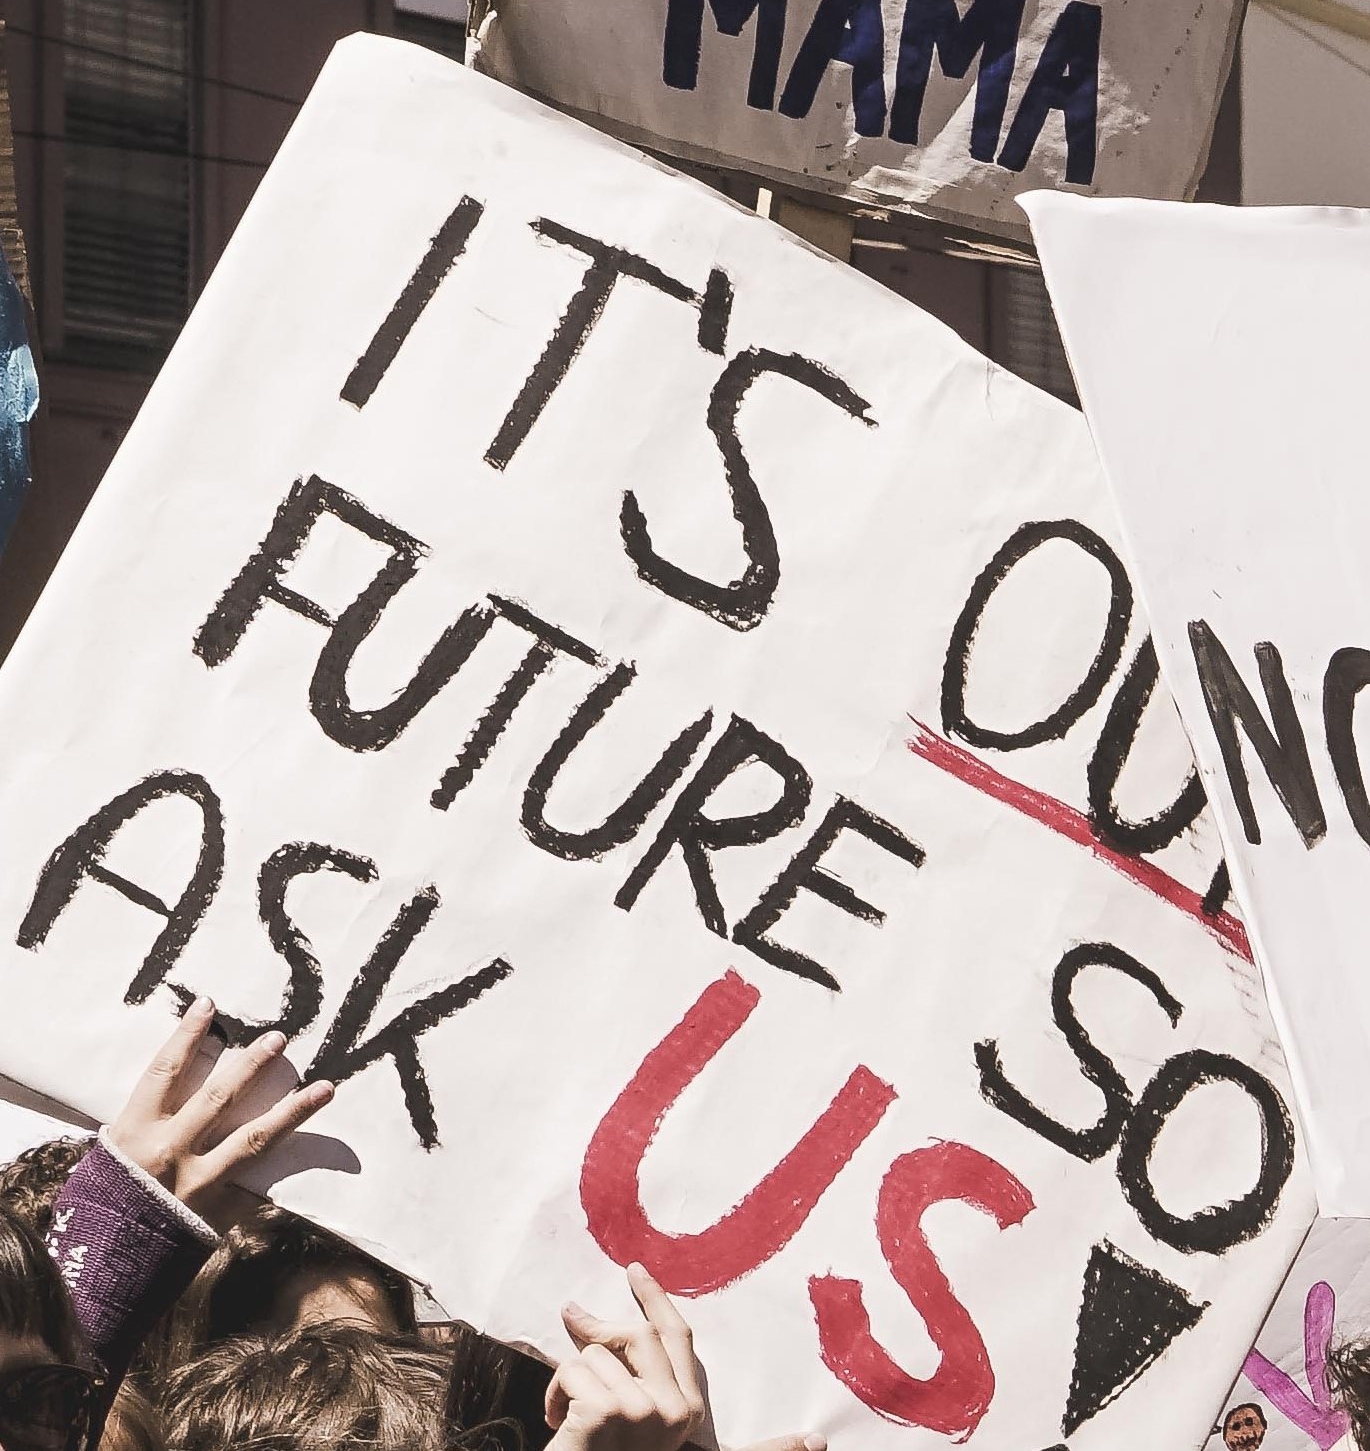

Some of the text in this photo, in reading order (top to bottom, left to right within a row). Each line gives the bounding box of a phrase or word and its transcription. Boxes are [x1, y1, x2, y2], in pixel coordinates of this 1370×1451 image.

[192, 474, 1296, 1257] FUTURE SO
[339, 195, 1232, 917] IT'S OU
[16, 769, 514, 1153] ASK
